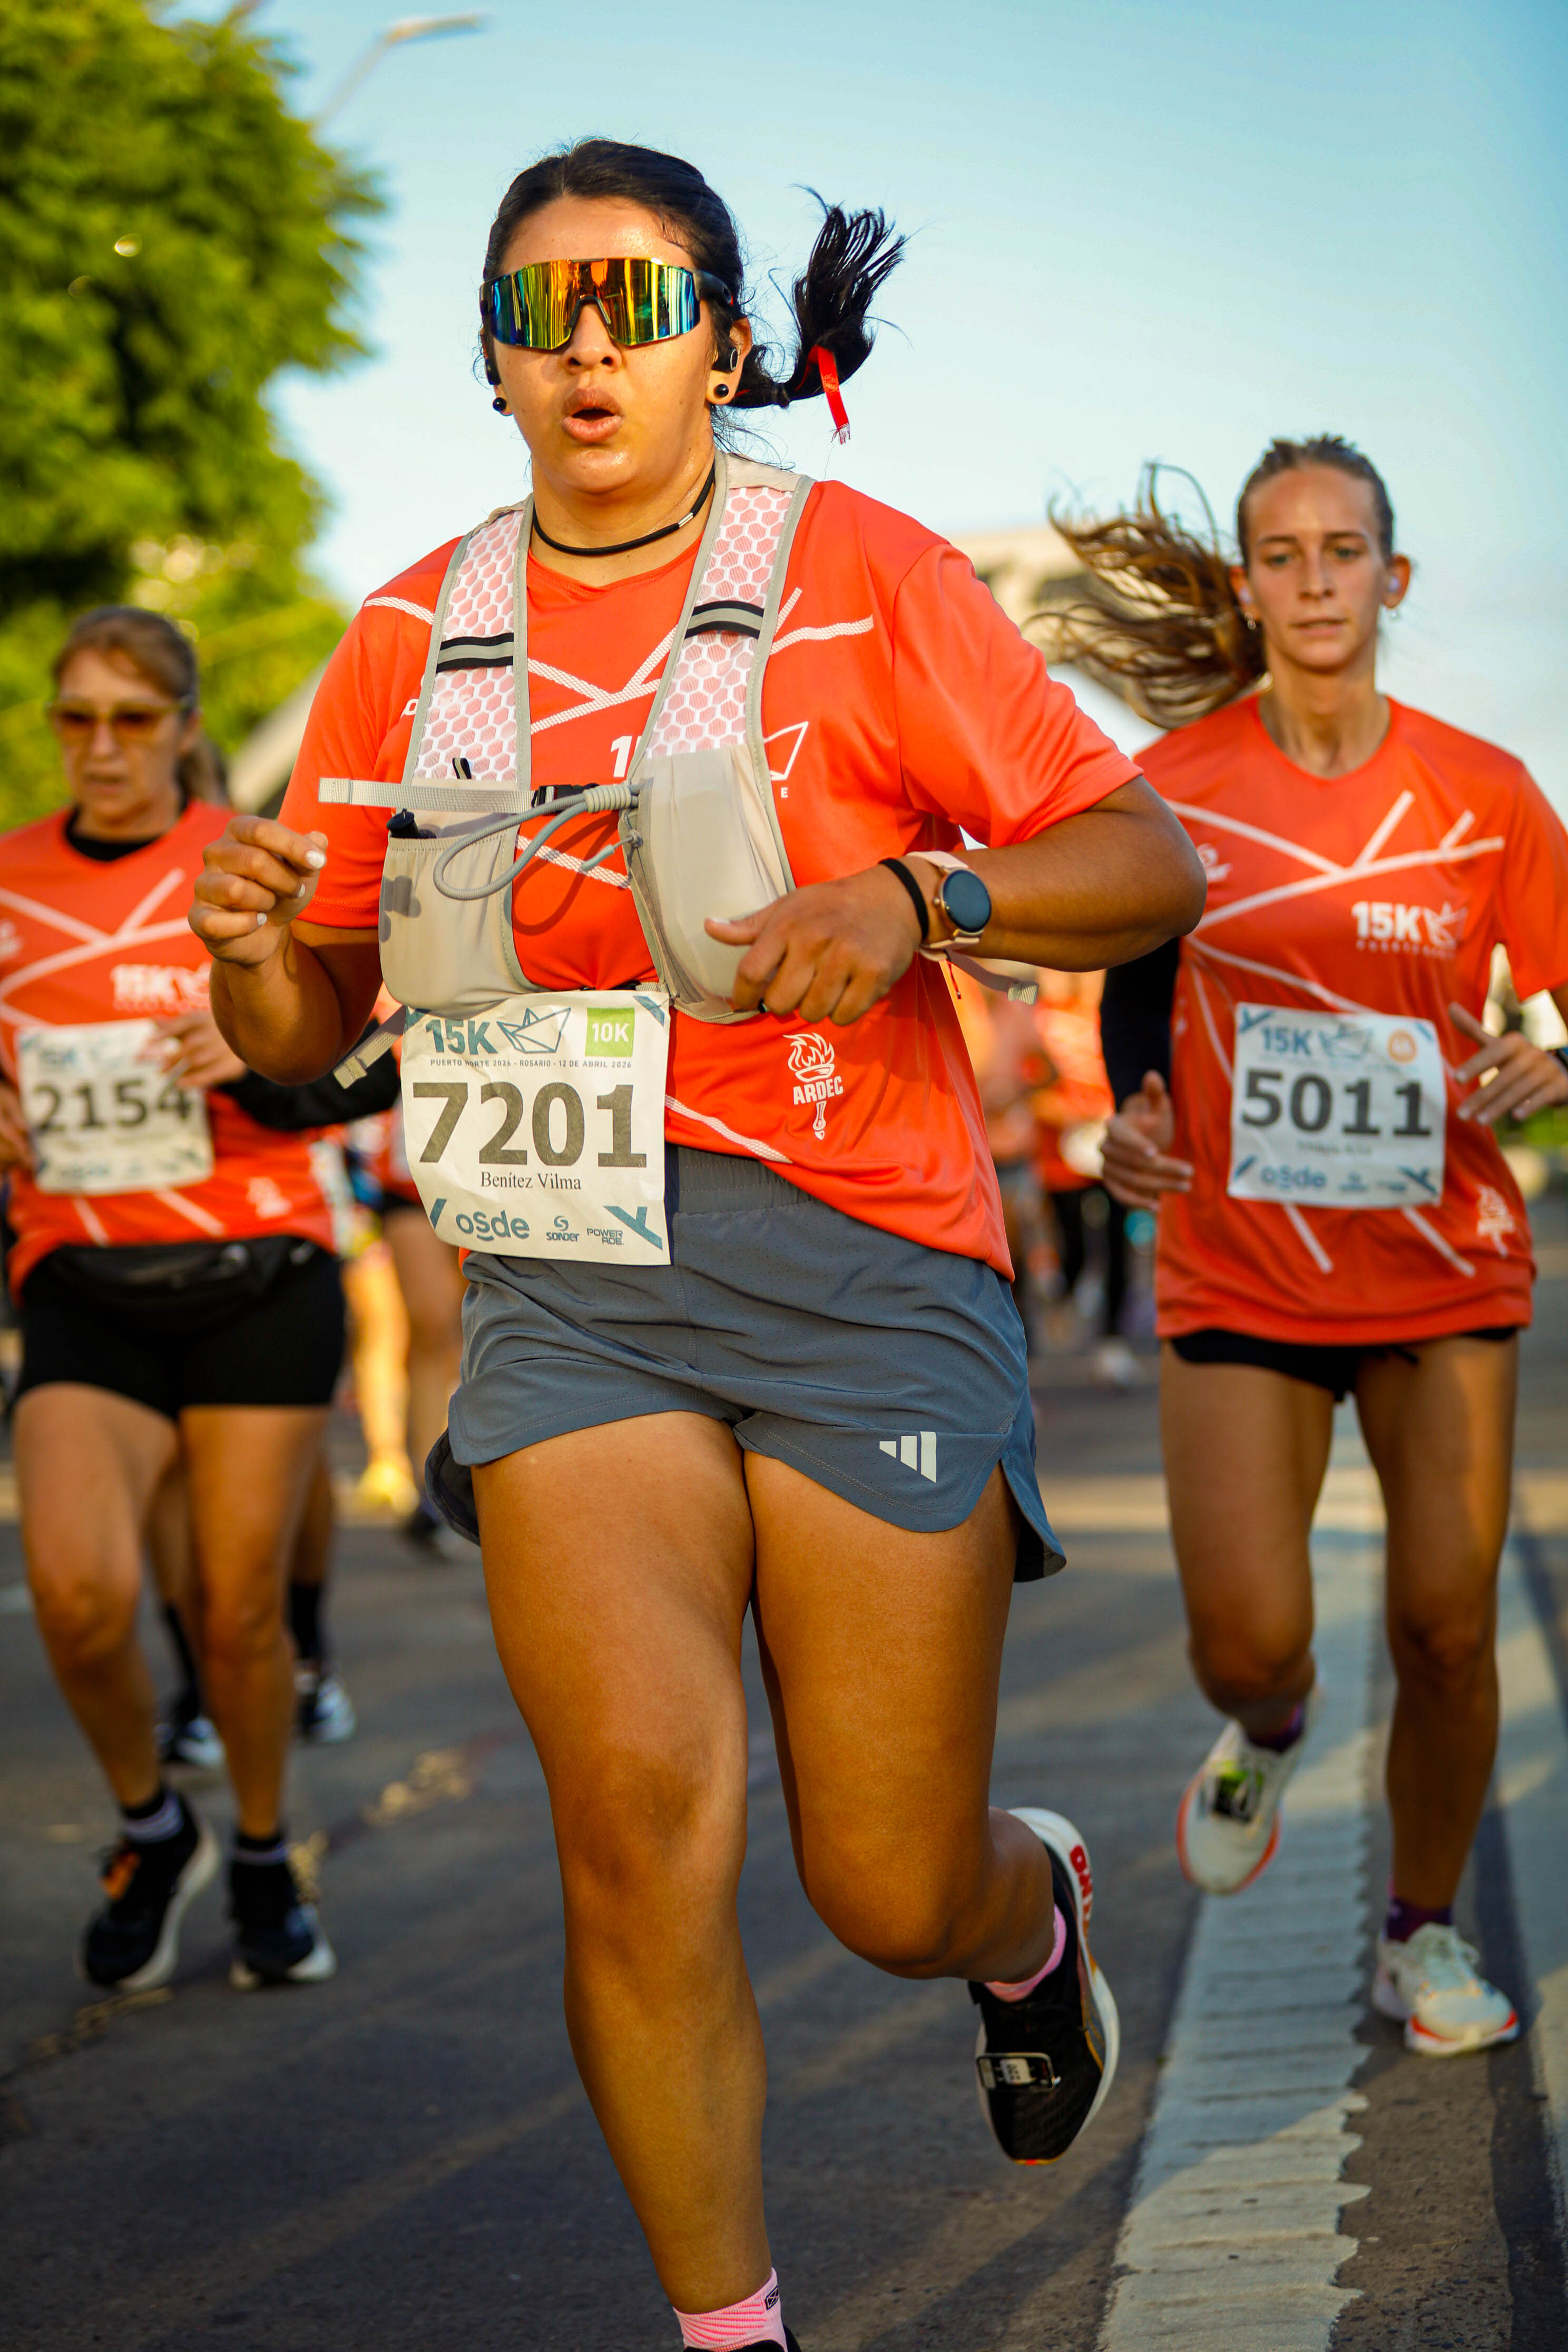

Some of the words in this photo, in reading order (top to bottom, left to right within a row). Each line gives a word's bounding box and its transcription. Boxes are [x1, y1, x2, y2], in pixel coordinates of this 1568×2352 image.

[1351, 901, 1422, 943] 15K
[425, 1019, 498, 1055] 15K
[591, 1022, 630, 1043] 10K
[1262, 1026, 1312, 1056] 15K
[34, 1077, 191, 1132] 2154
[792, 1075, 844, 1105] ARDEC
[1241, 1069, 1432, 1138] 5011
[413, 1082, 647, 1168] 7201
[480, 1171, 533, 1189] Benítez
[536, 1172, 582, 1190] Vilma
[455, 1209, 530, 1241] osde
[586, 1228, 623, 1238] POWER
